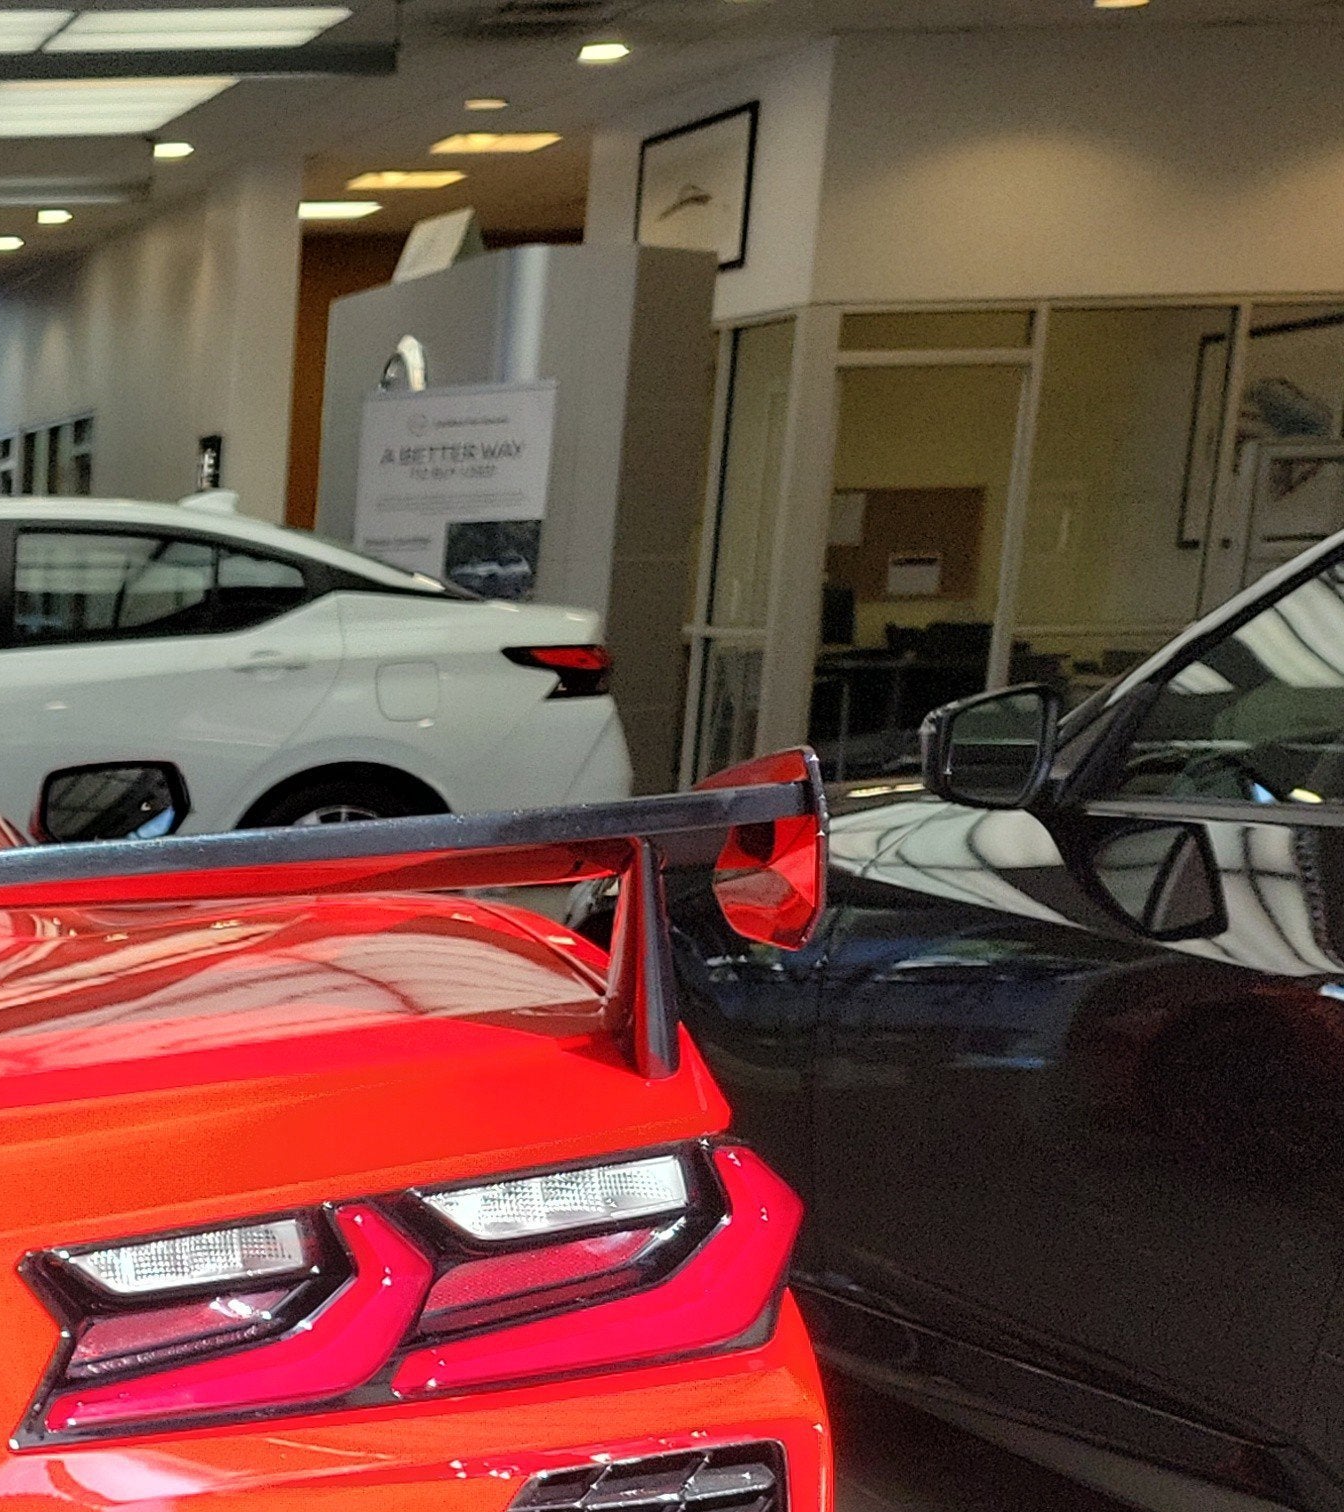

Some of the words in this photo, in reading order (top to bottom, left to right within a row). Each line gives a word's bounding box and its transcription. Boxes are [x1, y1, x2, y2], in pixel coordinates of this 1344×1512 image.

[380, 446, 395, 464] A
[399, 443, 475, 465] BETTER
[480, 438, 525, 460] WAY
